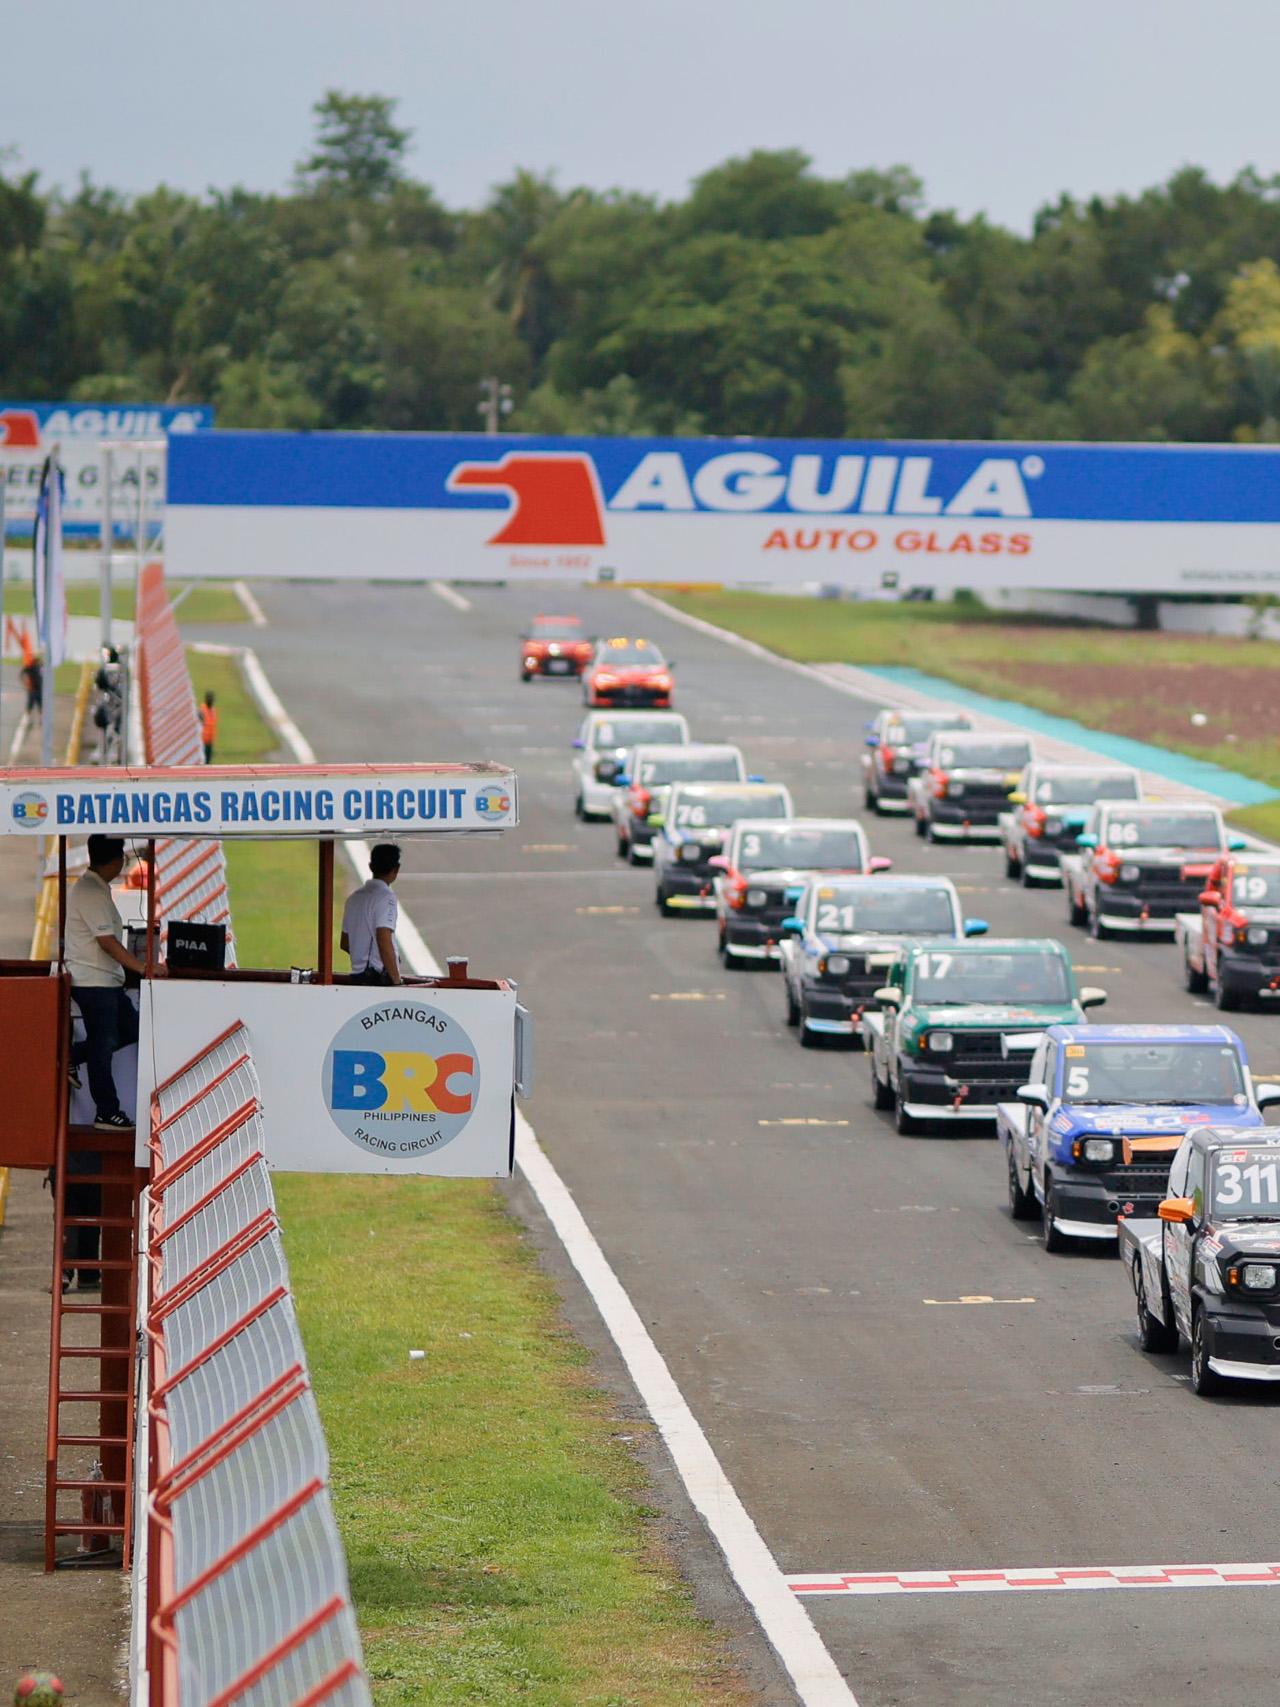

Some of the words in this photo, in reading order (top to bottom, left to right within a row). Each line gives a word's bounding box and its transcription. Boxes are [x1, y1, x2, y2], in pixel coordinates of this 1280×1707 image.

[43, 408, 198, 435] AGUILA
[606, 450, 1031, 516] AGUILA
[763, 529, 878, 553] AUTO
[894, 530, 1033, 556] GLASS
[56, 792, 212, 825] BATANGAS
[220, 790, 335, 822] RACING
[342, 789, 467, 821] CIRCUIT
[677, 805, 706, 826] 76
[1108, 823, 1138, 844] 86
[1234, 877, 1268, 899] 19
[818, 904, 854, 929] 21
[175, 938, 208, 951] PIAA
[914, 953, 952, 979] 17
[360, 1007, 448, 1033] BATANGAS
[331, 1050, 474, 1115] BRC
[1066, 1066, 1090, 1097] 5
[363, 1112, 437, 1122] PHILIPPINES
[354, 1127, 397, 1151] RACING
[400, 1130, 443, 1152] CIRCUIT
[1216, 1163, 1279, 1205] 311
